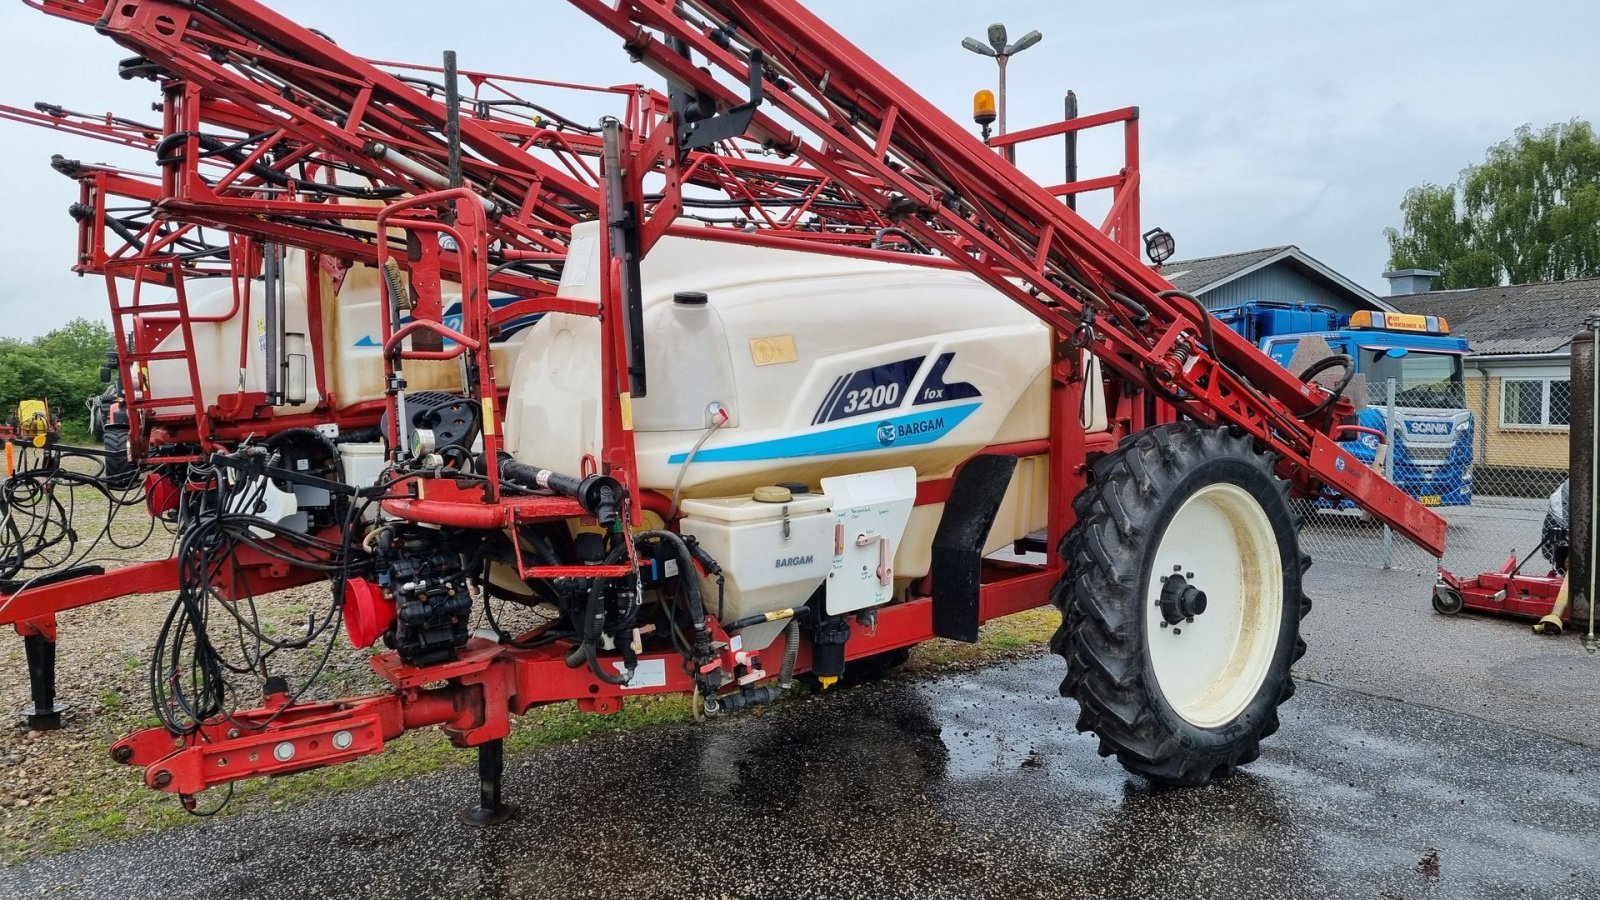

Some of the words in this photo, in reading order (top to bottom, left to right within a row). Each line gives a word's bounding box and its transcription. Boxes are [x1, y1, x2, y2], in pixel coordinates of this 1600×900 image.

[844, 383, 899, 412] 3200
[924, 388, 944, 400] fox
[899, 418, 944, 436] BARGAM
[1412, 422, 1448, 434] SCANIA
[775, 555, 813, 569] BARGAM
